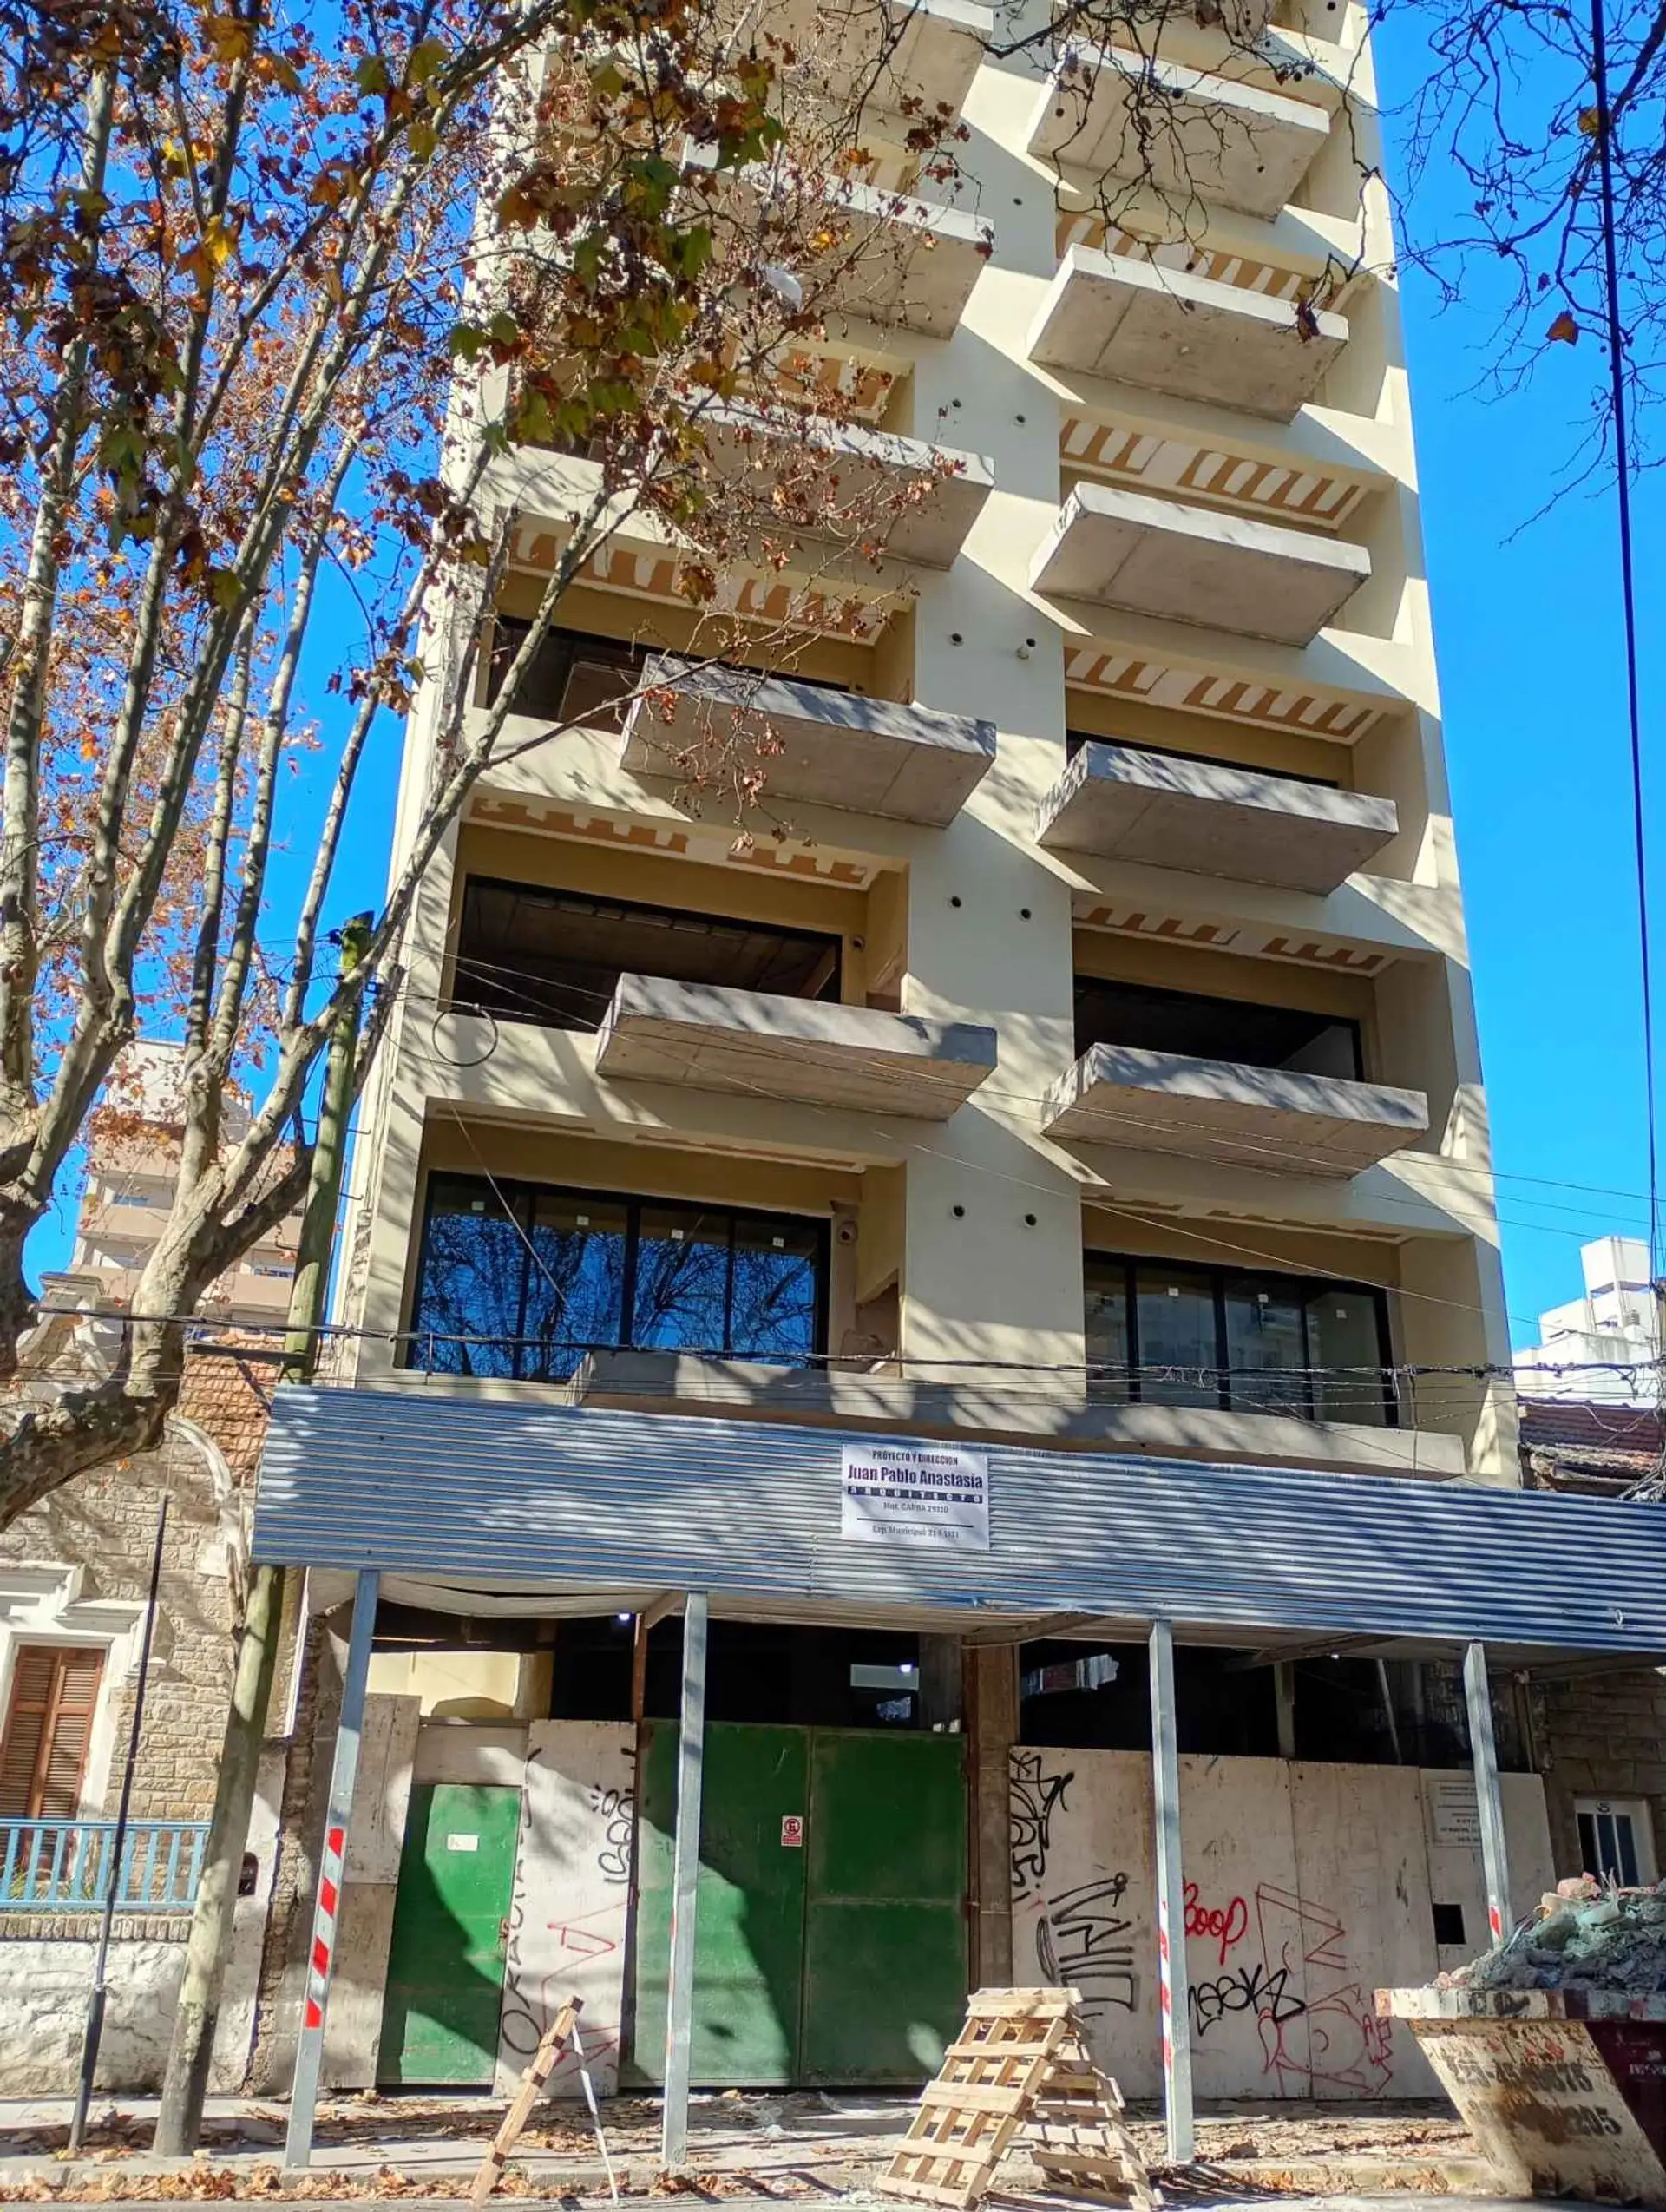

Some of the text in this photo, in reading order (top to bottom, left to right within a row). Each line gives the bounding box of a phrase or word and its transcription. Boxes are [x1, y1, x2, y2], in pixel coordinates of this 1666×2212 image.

[872, 1450, 910, 1462] PROYECTO
[848, 1465, 877, 1480] Juan
[881, 1467, 917, 1484] Pablo
